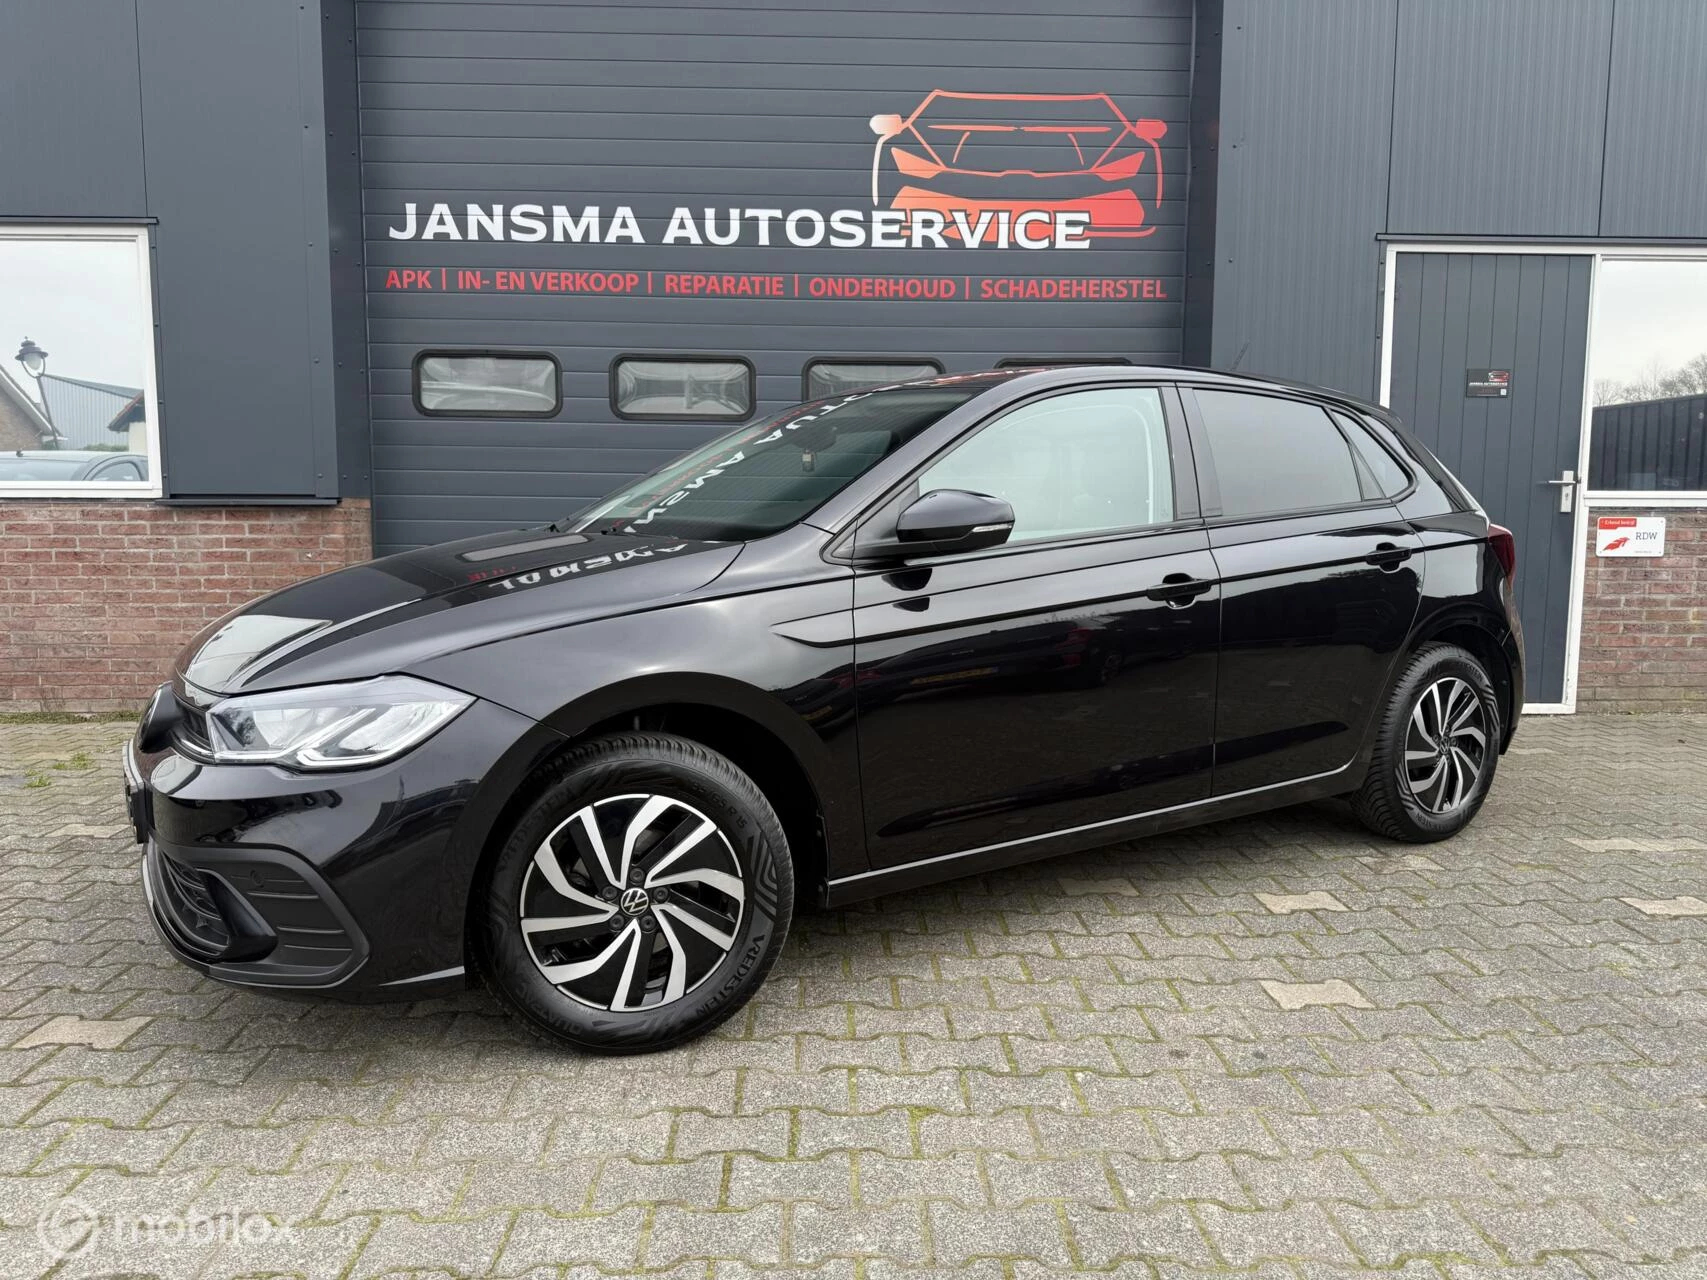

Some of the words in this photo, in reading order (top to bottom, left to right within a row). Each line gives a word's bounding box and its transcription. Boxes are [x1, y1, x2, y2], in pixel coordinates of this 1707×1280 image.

[388, 203, 646, 243] JANSMA
[661, 207, 1091, 250] AUTOSERVICE
[385, 270, 432, 290] APK
[457, 270, 490, 290] IN-
[495, 271, 525, 291] EN
[529, 271, 639, 293] VERKOOP
[664, 274, 784, 297] REPARATIE
[808, 277, 957, 299] ONDERHOUD
[980, 279, 1168, 300] SCHADEHERSTEL
[1635, 531, 1658, 541] RDW
[695, 934, 766, 1017] VREDESTEIN
